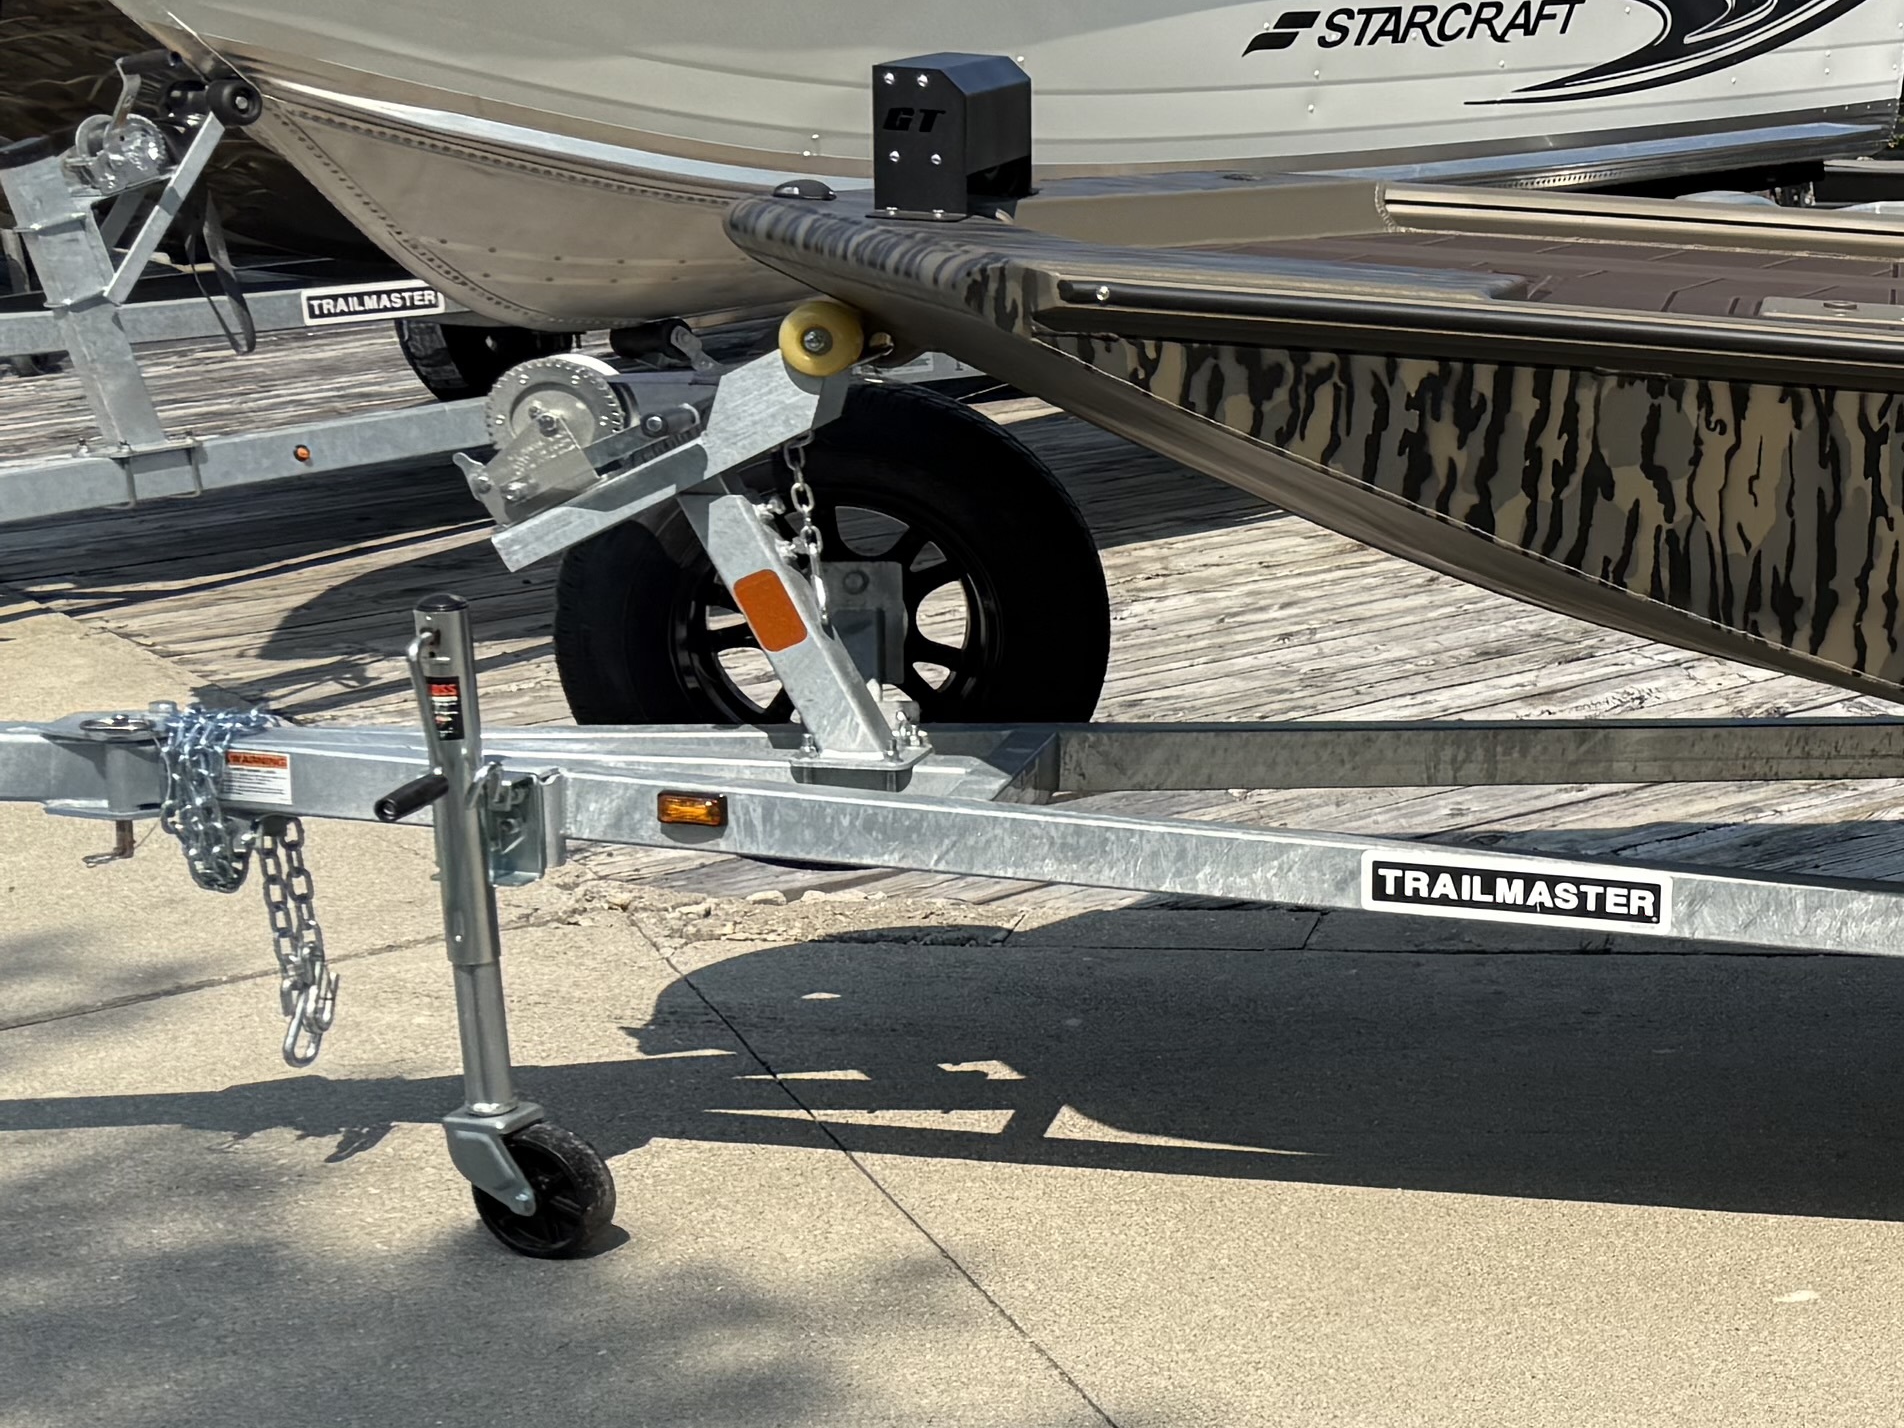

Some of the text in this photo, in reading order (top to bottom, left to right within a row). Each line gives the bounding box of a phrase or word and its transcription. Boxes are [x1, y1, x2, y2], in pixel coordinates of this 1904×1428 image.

[882, 106, 947, 133] GT
[309, 289, 437, 315] TRAILMASTER
[1377, 867, 1656, 917] TRAILMASTER
